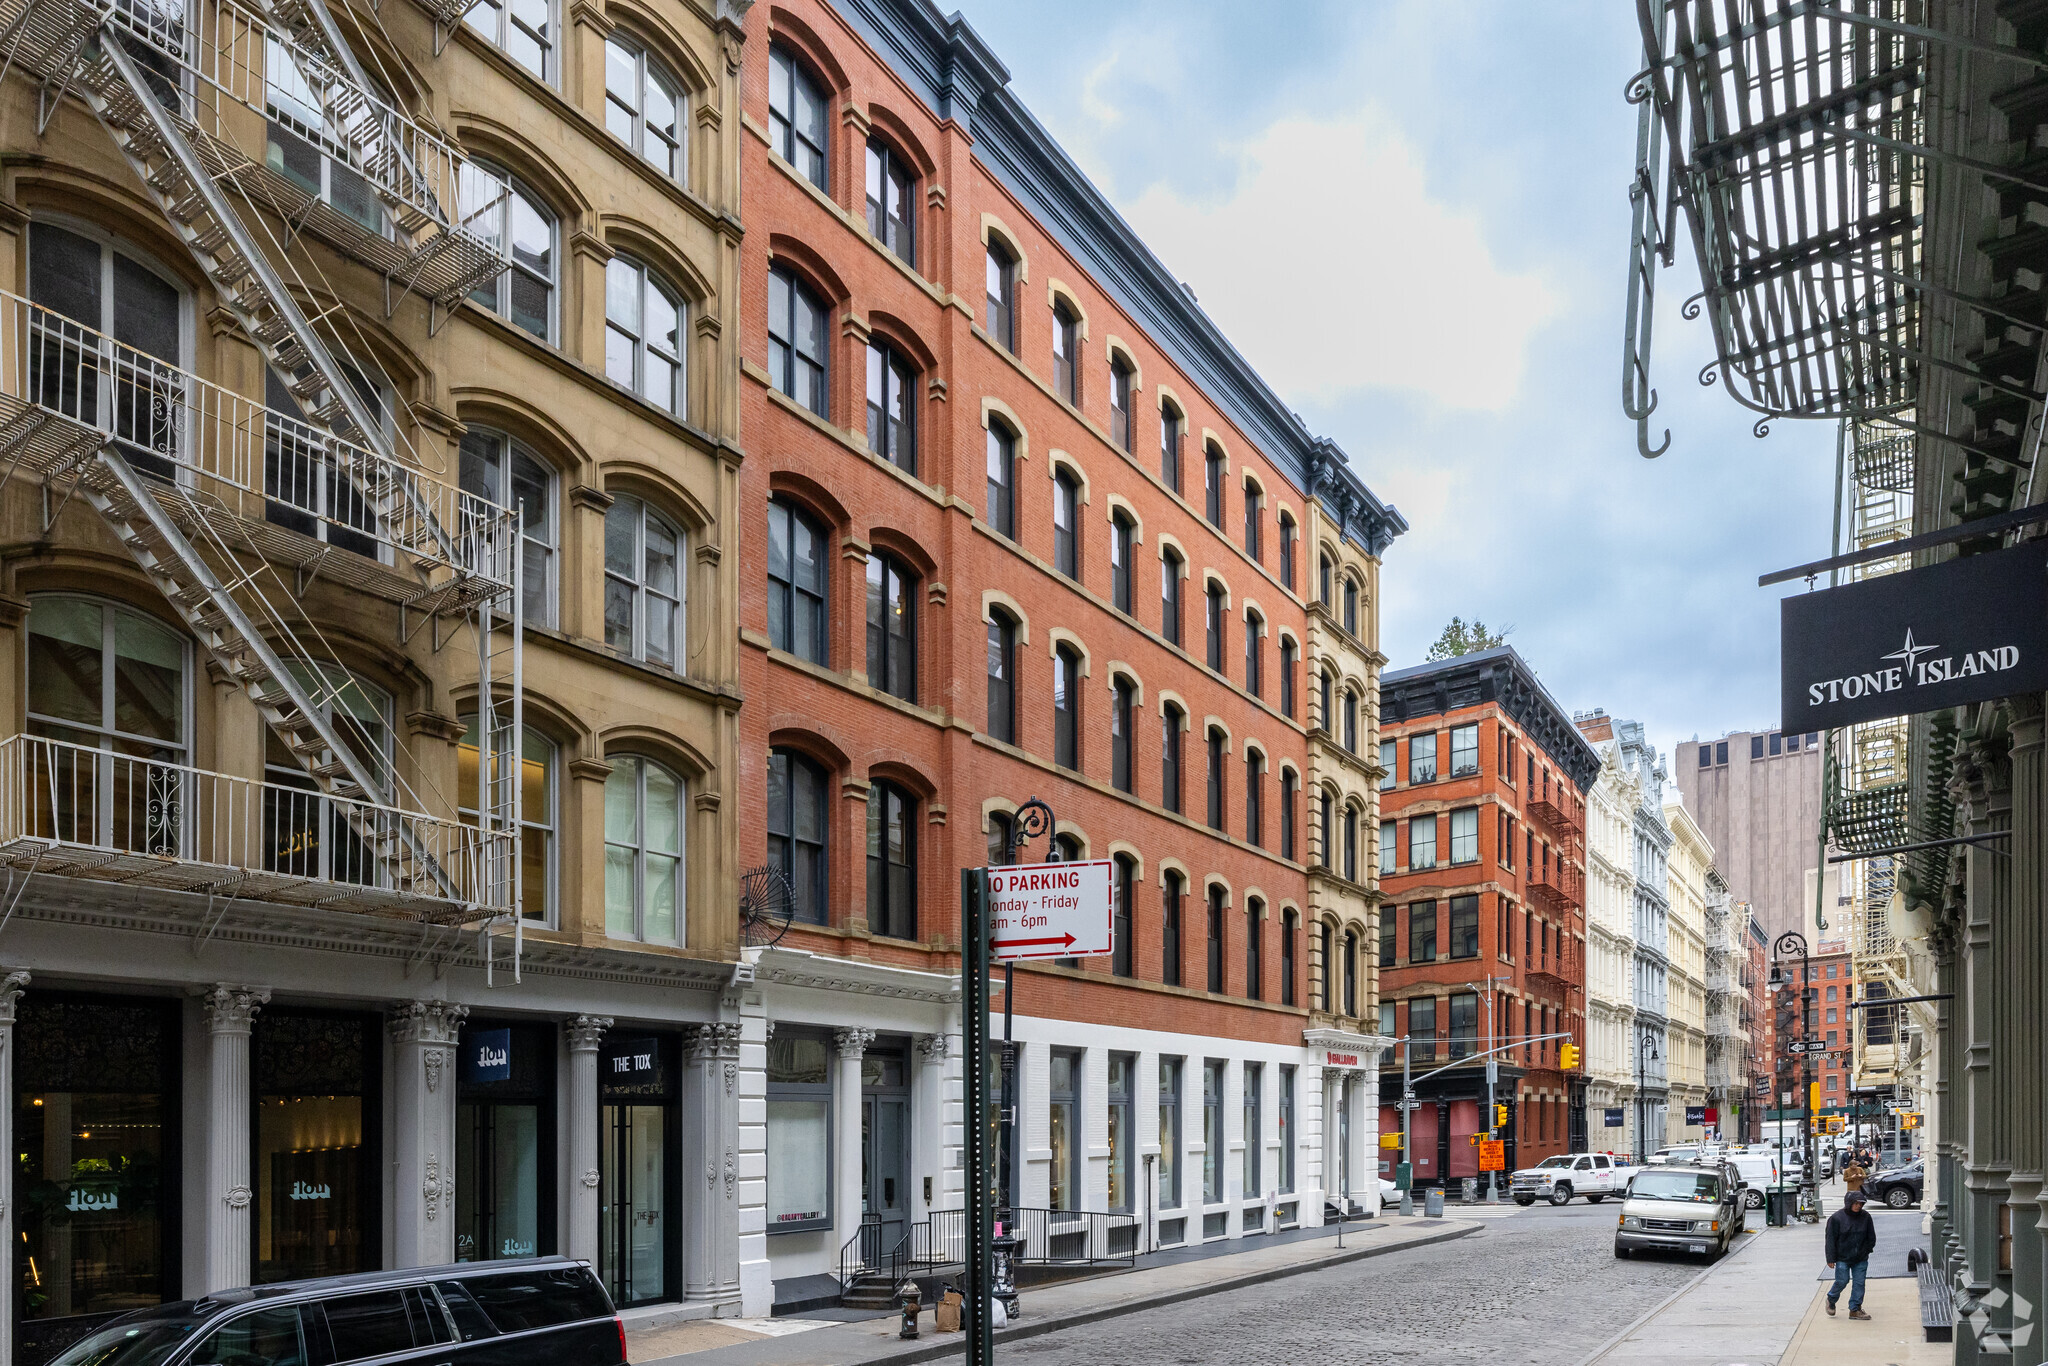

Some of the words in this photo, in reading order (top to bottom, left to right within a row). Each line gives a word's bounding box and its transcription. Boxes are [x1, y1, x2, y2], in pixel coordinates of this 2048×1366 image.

[1809, 667, 1902, 707] STONE
[1917, 645, 2020, 686] ISLAND
[1009, 871, 1080, 892] PARKING
[988, 898, 1028, 913] onday
[1041, 895, 1079, 910] Friday
[1021, 914, 1047, 929] 6pm
[477, 1046, 507, 1067] flou
[612, 1057, 630, 1073] THE
[633, 1054, 651, 1070] TOX
[65, 1189, 118, 1211] flou
[289, 1181, 331, 1200] flou
[637, 1211, 647, 1220] THE
[458, 1234, 474, 1247] 2A
[501, 1238, 533, 1255] flou
